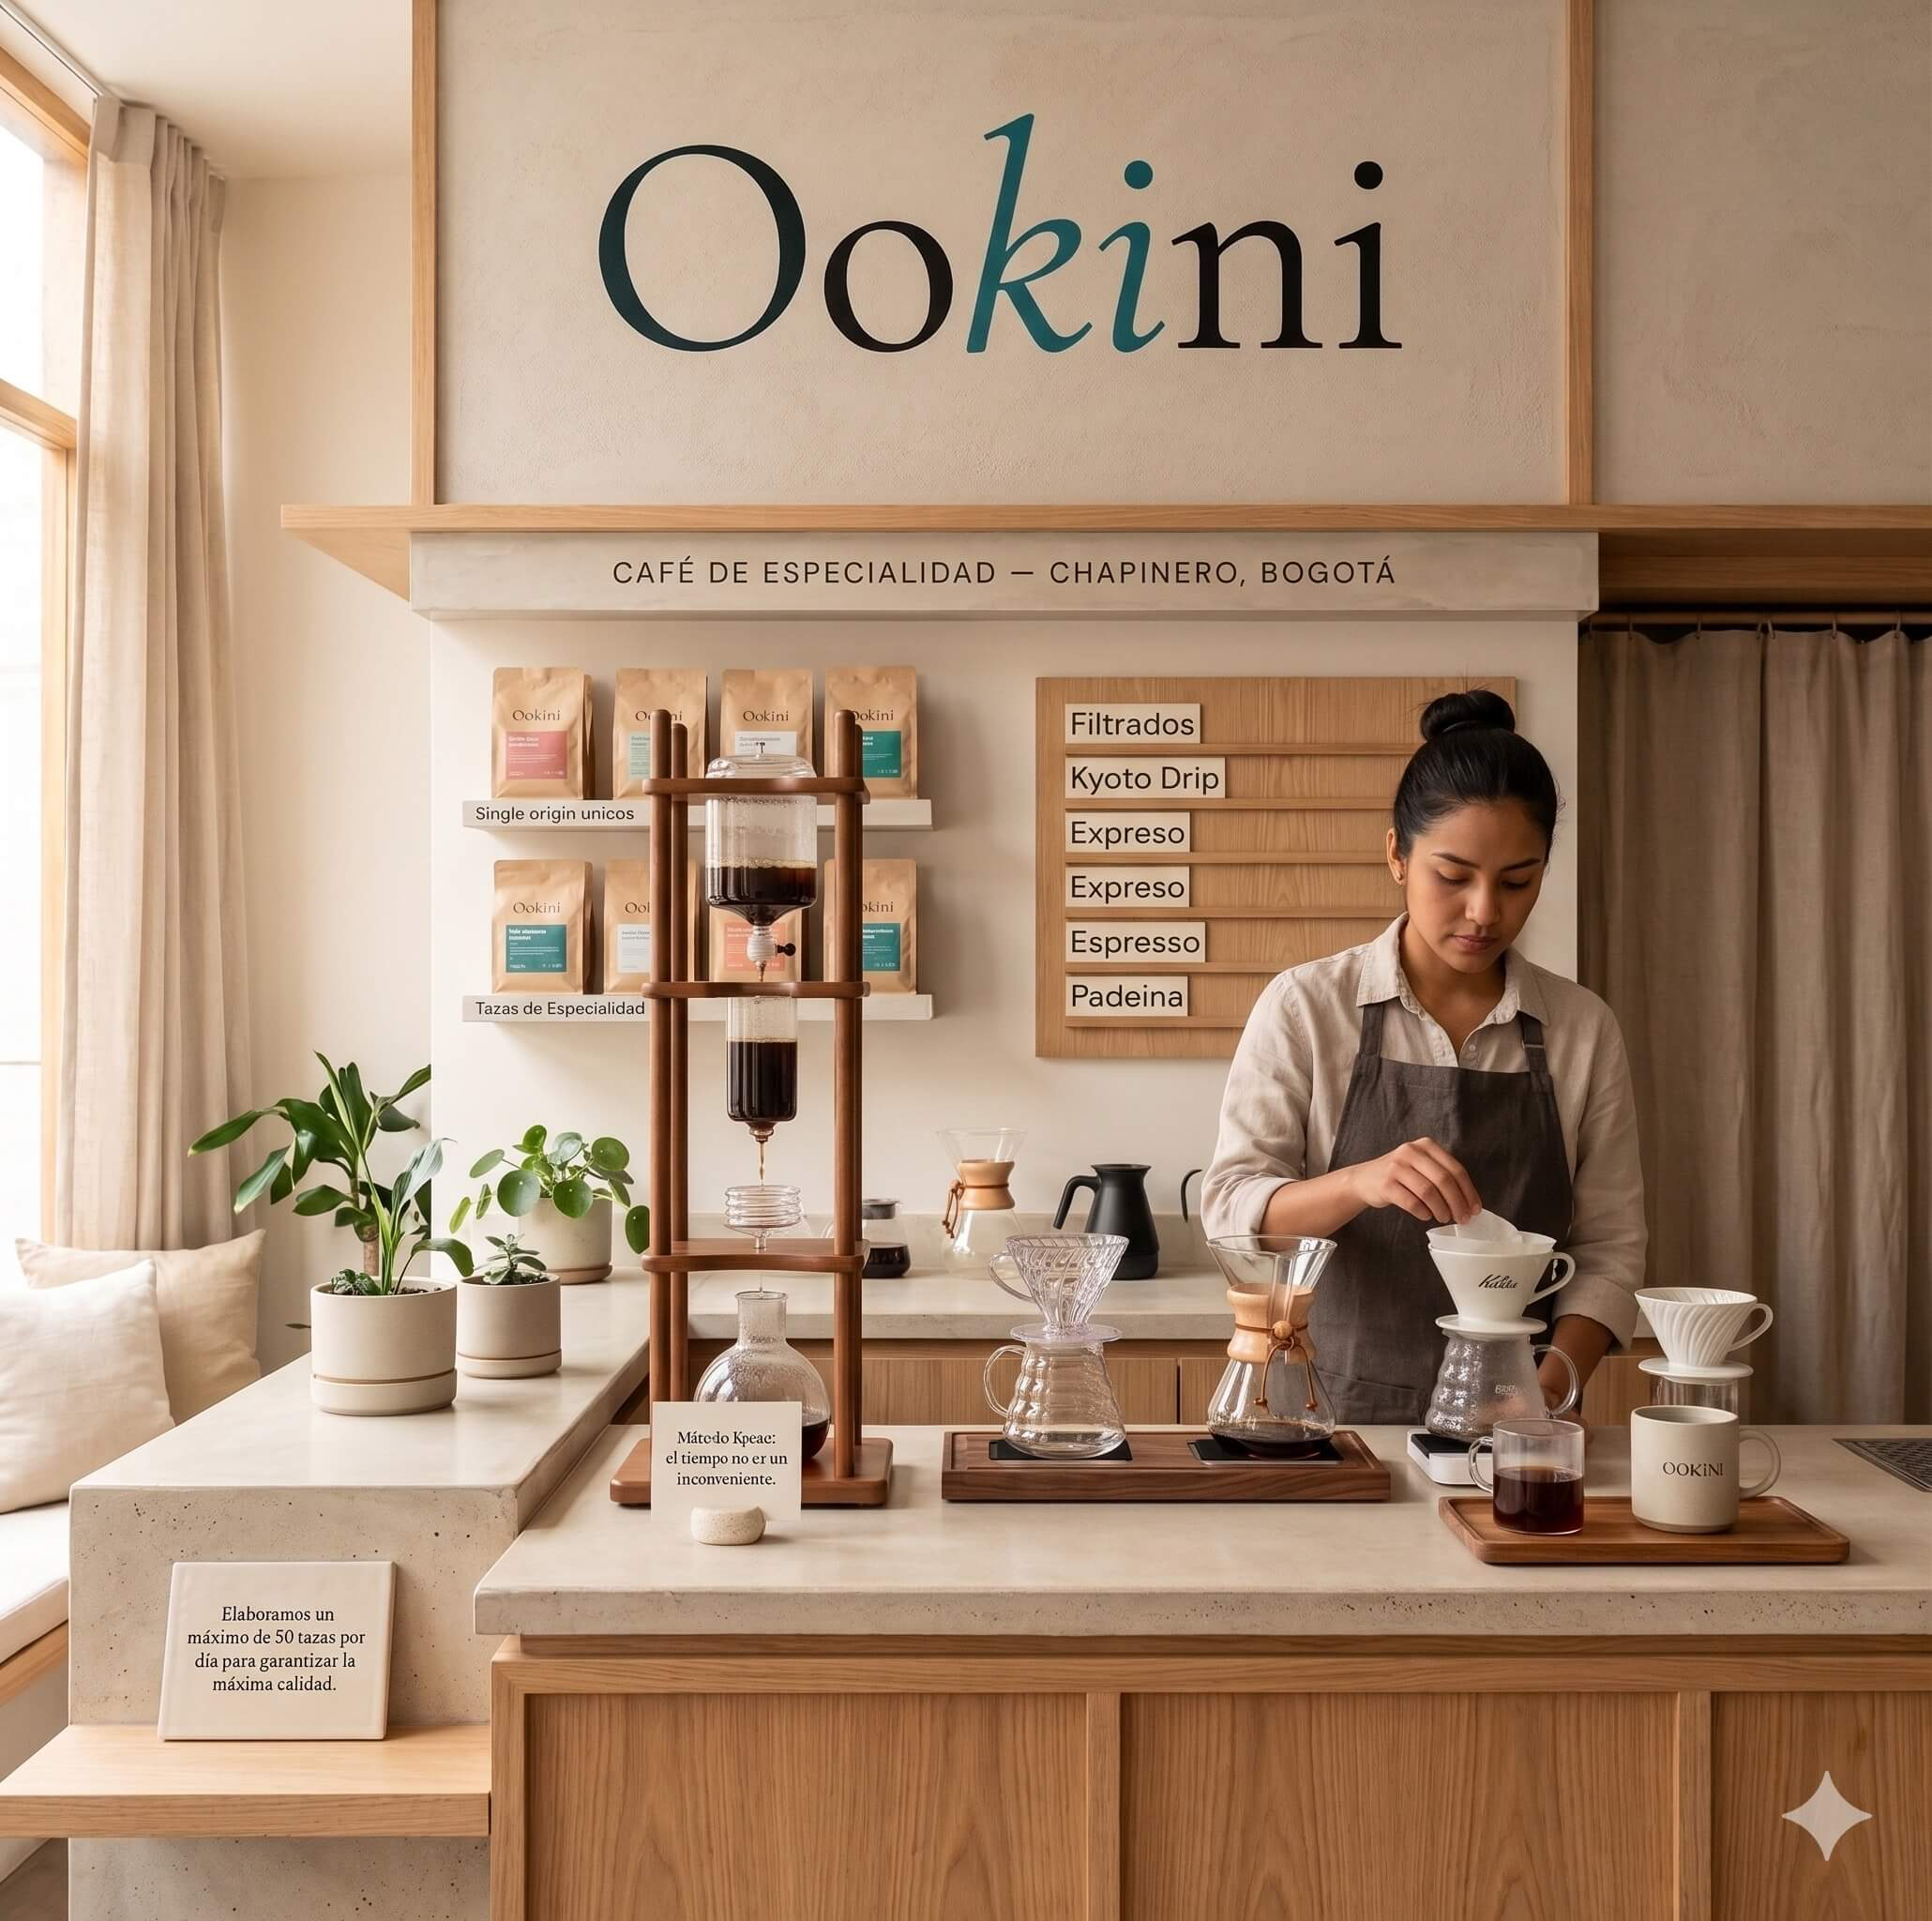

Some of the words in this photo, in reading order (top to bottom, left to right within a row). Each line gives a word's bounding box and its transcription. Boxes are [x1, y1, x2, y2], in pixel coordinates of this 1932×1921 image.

[598, 113, 1403, 354] Ookini
[613, 555, 694, 584] CAFÉ
[710, 561, 748, 583] DE
[763, 561, 995, 584] ESPECIALIDAD
[1049, 561, 1245, 587] CHAPINERO,
[1261, 554, 1396, 584] BOGOTÁ
[512, 708, 561, 721] Ookini
[742, 709, 789, 722] Ookini
[1071, 712, 1195, 736] Filtrados
[1072, 765, 1152, 795] Kyoto
[1161, 765, 1219, 795] Drip
[475, 806, 525, 824] Single
[529, 806, 576, 824] origin
[581, 806, 635, 820] unicos
[1071, 821, 1185, 851] Expreso
[1071, 875, 1185, 905] Expreso
[512, 900, 560, 914] Ookini
[863, 900, 894, 913] okini
[1071, 930, 1200, 960] Espresso
[1072, 984, 1183, 1007] Padeina
[475, 1001, 519, 1015] Tazas
[522, 1001, 543, 1015] de
[547, 1001, 645, 1019] Especialidad
[666, 1450, 677, 1464] el
[681, 1451, 729, 1469] tiempo
[732, 1455, 749, 1465] no
[769, 1455, 788, 1465] un
[677, 1472, 777, 1486] inconveniente.
[221, 1605, 311, 1622] Elaboramos
[315, 1611, 335, 1622] un
[187, 1628, 249, 1644] máximo
[253, 1628, 271, 1644] de
[275, 1629, 294, 1644] 50
[297, 1632, 336, 1644] tazas
[340, 1633, 366, 1649] por
[194, 1652, 219, 1668] día
[221, 1656, 256, 1673] para
[259, 1652, 339, 1672] garantizar
[342, 1652, 356, 1668] la
[212, 1675, 273, 1691] máxima
[277, 1674, 337, 1691] calidad.
